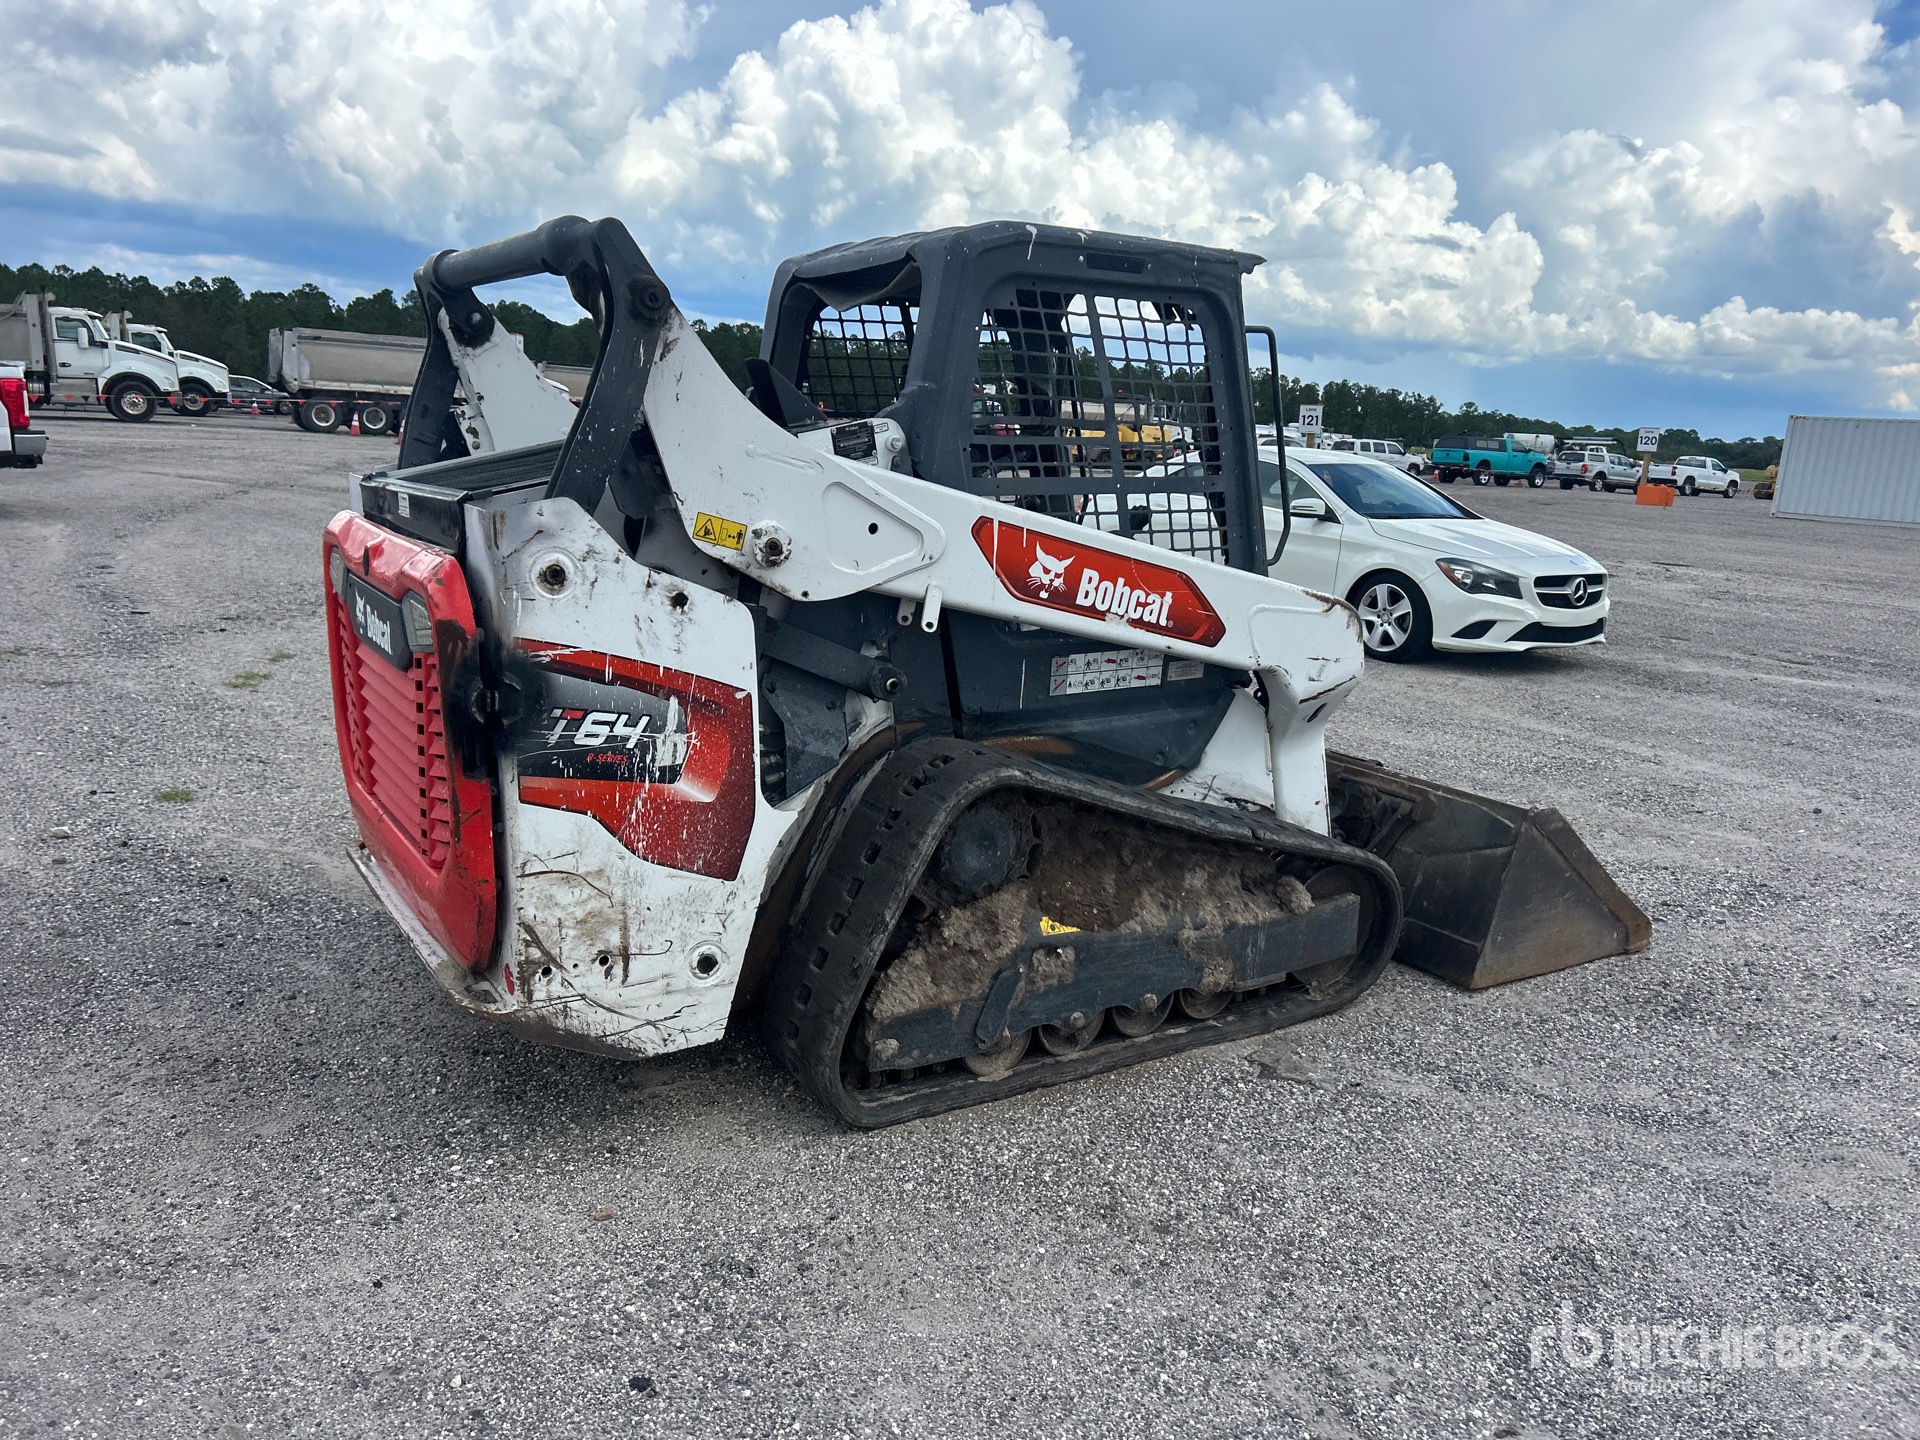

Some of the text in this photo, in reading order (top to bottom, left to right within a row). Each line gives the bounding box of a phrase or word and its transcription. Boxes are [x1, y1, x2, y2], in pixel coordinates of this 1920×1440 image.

[1301, 414, 1319, 426] 121
[1639, 435, 1658, 446] 120
[1075, 567, 1173, 627] Bobcat
[546, 708, 651, 749] T64
